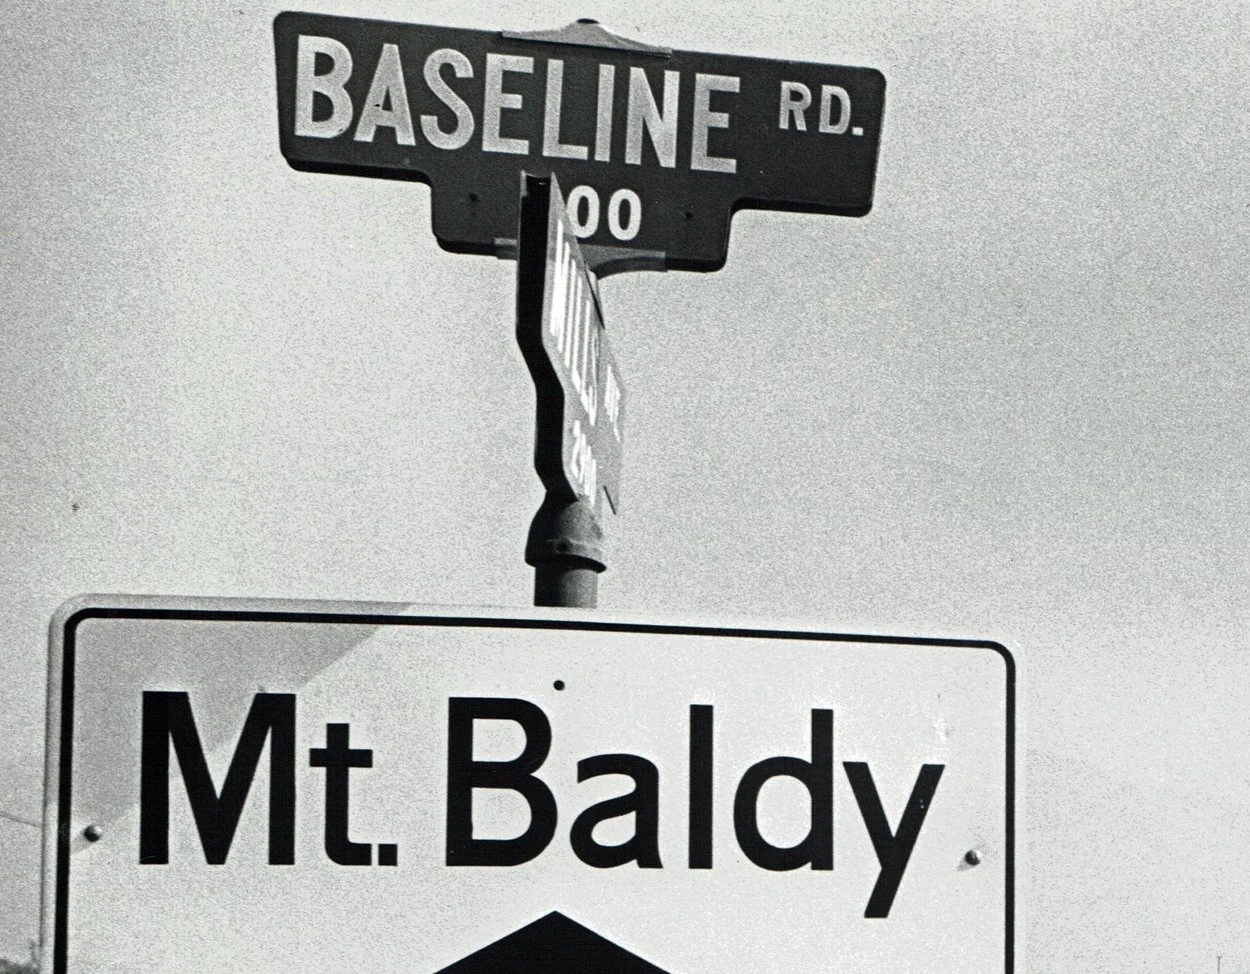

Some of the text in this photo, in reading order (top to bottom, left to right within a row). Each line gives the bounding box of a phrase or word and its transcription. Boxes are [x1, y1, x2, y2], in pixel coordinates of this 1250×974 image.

[294, 35, 863, 174] BASELINE RD.
[140, 691, 944, 919] Mt. Baldy
